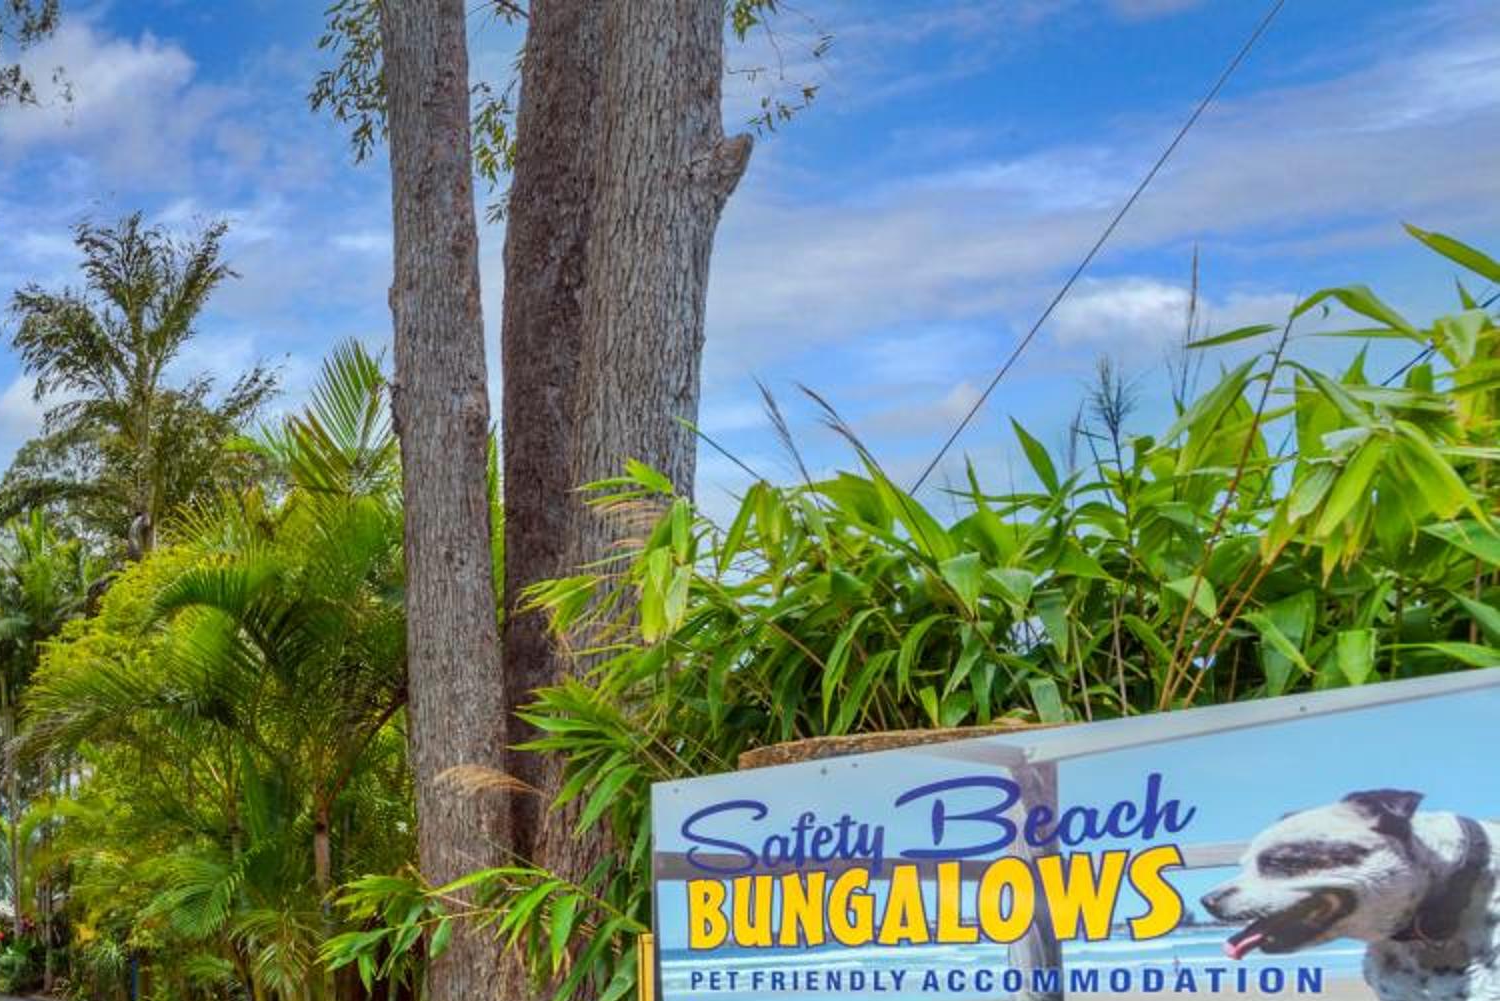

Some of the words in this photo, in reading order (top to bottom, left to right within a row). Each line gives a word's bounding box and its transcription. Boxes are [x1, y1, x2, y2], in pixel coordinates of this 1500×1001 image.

[681, 800, 885, 876] Safety
[894, 772, 1196, 859] Beach
[687, 844, 1186, 951] BUNGALOWS
[691, 971, 740, 991] PET
[752, 970, 907, 992] FRIENDLY
[921, 967, 1324, 993] ACCOMMODATION
